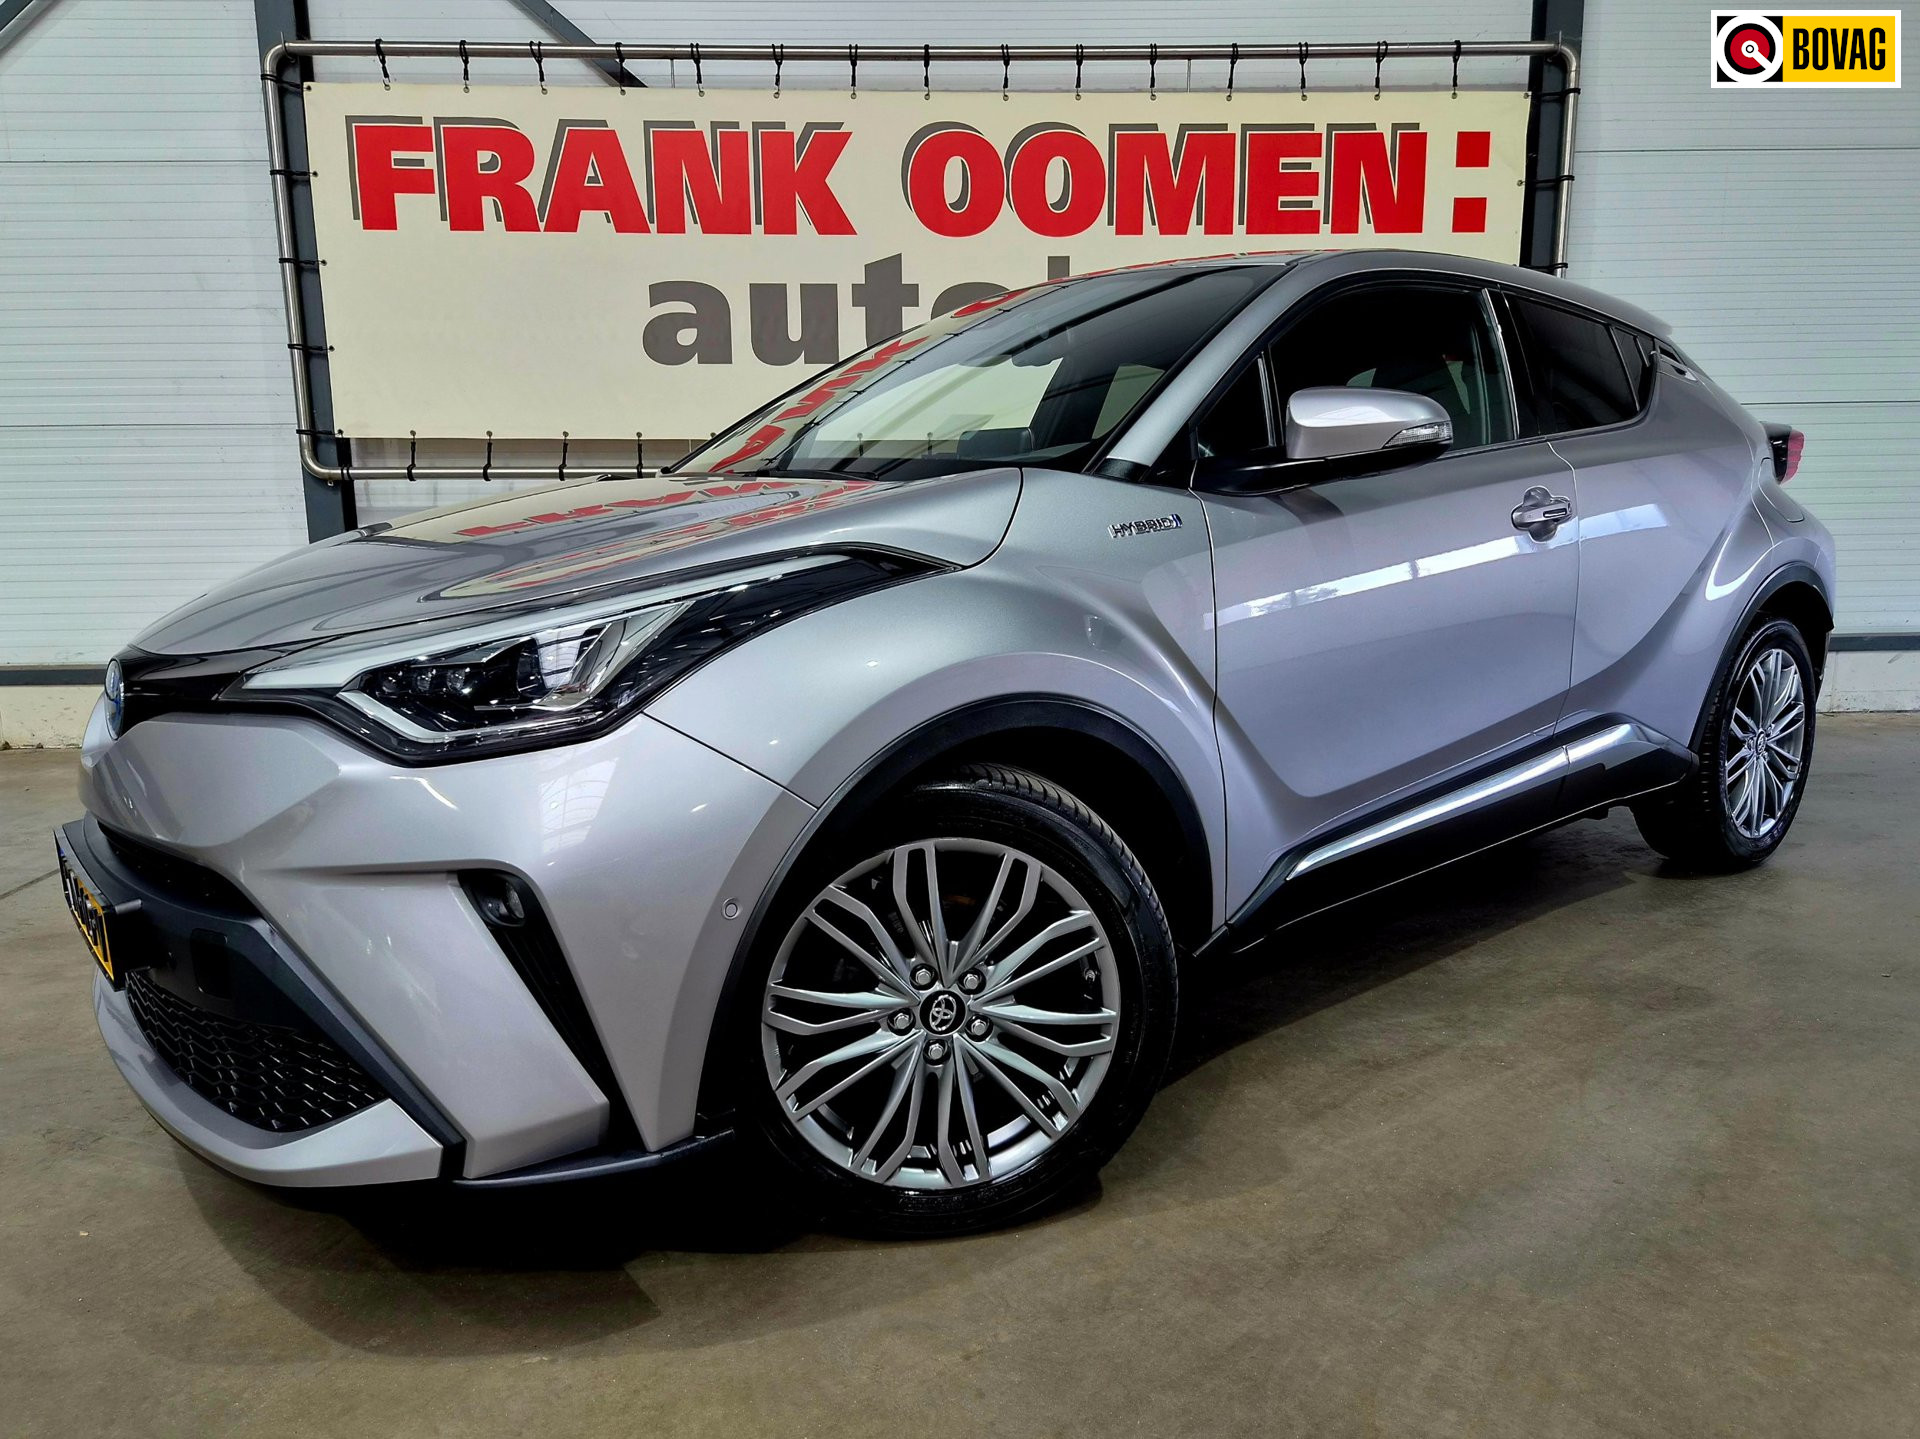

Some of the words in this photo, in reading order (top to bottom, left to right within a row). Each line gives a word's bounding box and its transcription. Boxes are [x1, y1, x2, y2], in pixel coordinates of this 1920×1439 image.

[345, 115, 857, 236] FRANK
[642, 253, 1070, 366] aut
[1107, 515, 1176, 539] HYBRID
